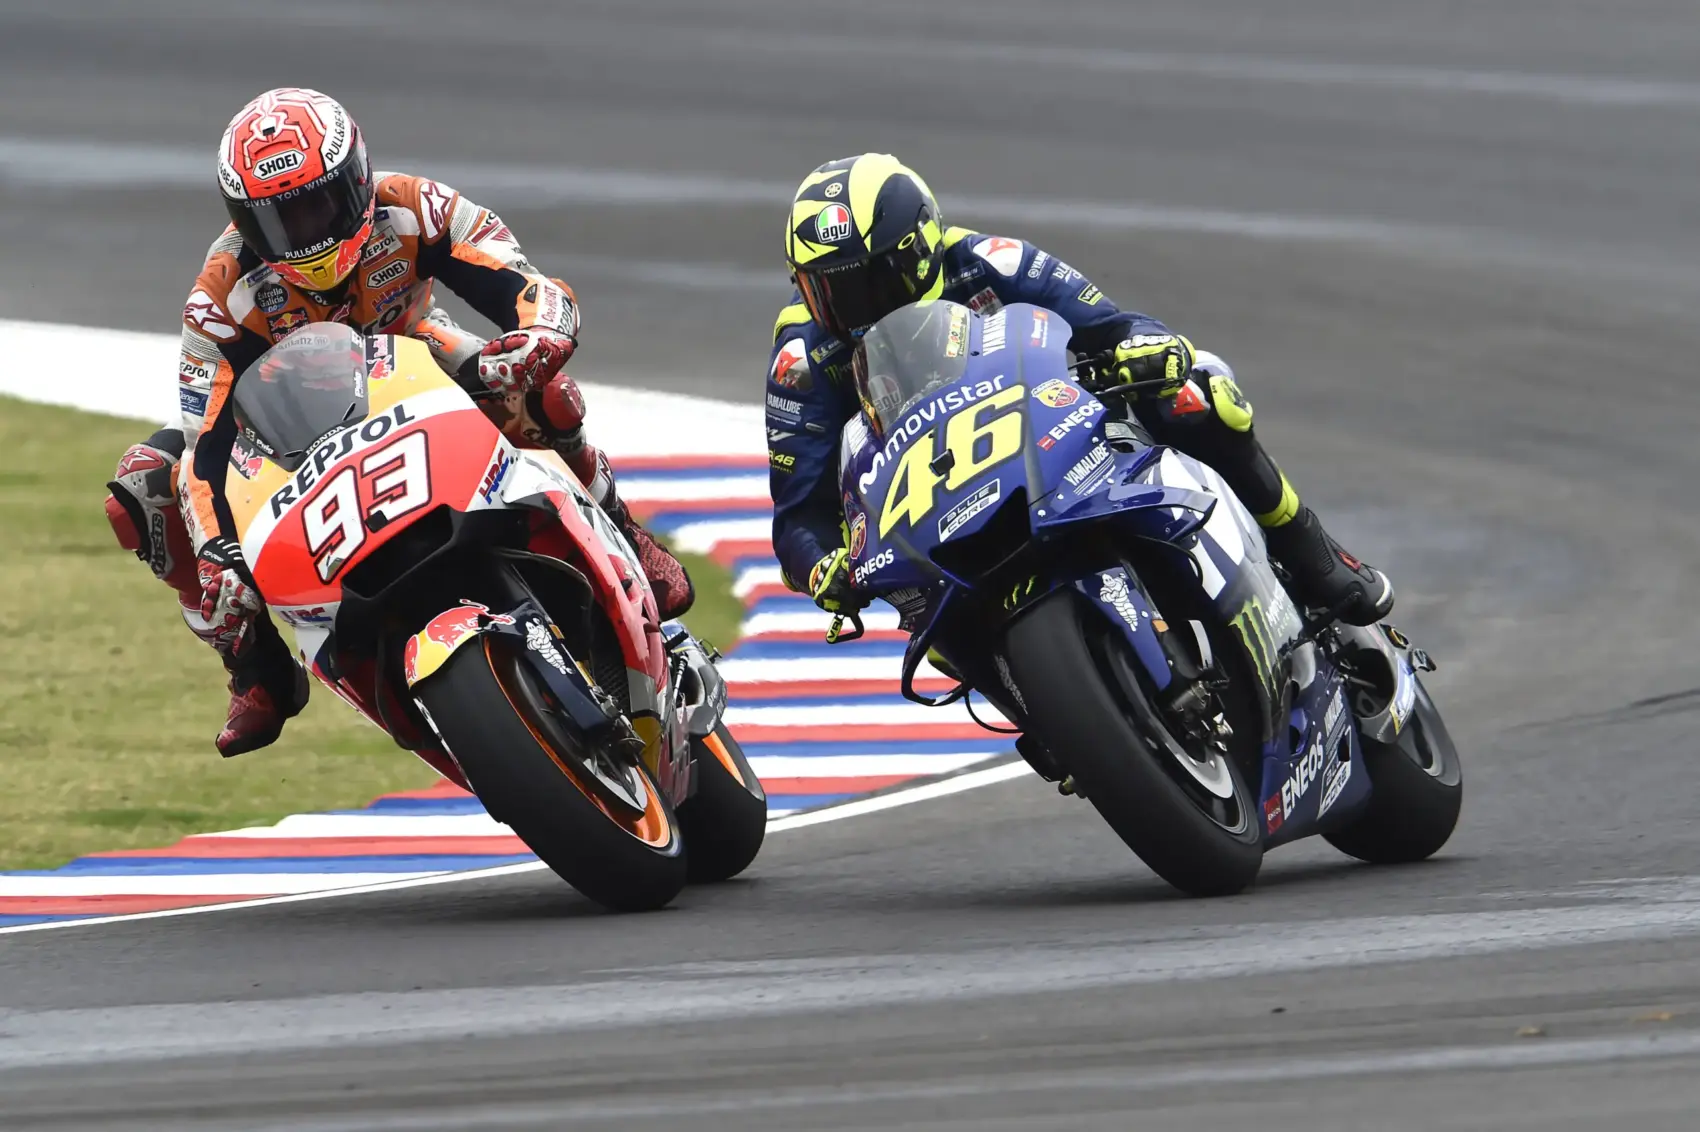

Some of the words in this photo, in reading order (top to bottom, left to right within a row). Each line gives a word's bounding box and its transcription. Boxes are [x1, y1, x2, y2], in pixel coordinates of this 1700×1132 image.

[258, 153, 298, 177] SHOEI
[244, 197, 271, 208] GIVES
[276, 189, 300, 201] YOU
[304, 169, 340, 191] WINGS
[285, 237, 335, 260] PULL&BEAR
[822, 223, 848, 239] agv
[371, 262, 405, 285] SHOEI
[257, 286, 283, 300] Estrella
[307, 291, 329, 306] SOL
[968, 289, 997, 313] MAHA
[556, 296, 573, 334] EPSO
[179, 362, 209, 379] EPSOL
[767, 393, 802, 415] YAMALUBE
[883, 375, 1005, 460] movistar
[1048, 399, 1104, 440] ENEOS
[256, 438, 274, 455] Puig
[306, 425, 346, 456] HONDA
[270, 404, 415, 520] REPSOL
[878, 384, 1026, 541] 46
[1063, 440, 1110, 487] YAMALUBE
[301, 429, 433, 585] 93
[946, 486, 990, 523] BLUE
[947, 498, 990, 533] CORE
[854, 548, 895, 584] ENEOS
[1281, 732, 1324, 821] ENEOS
